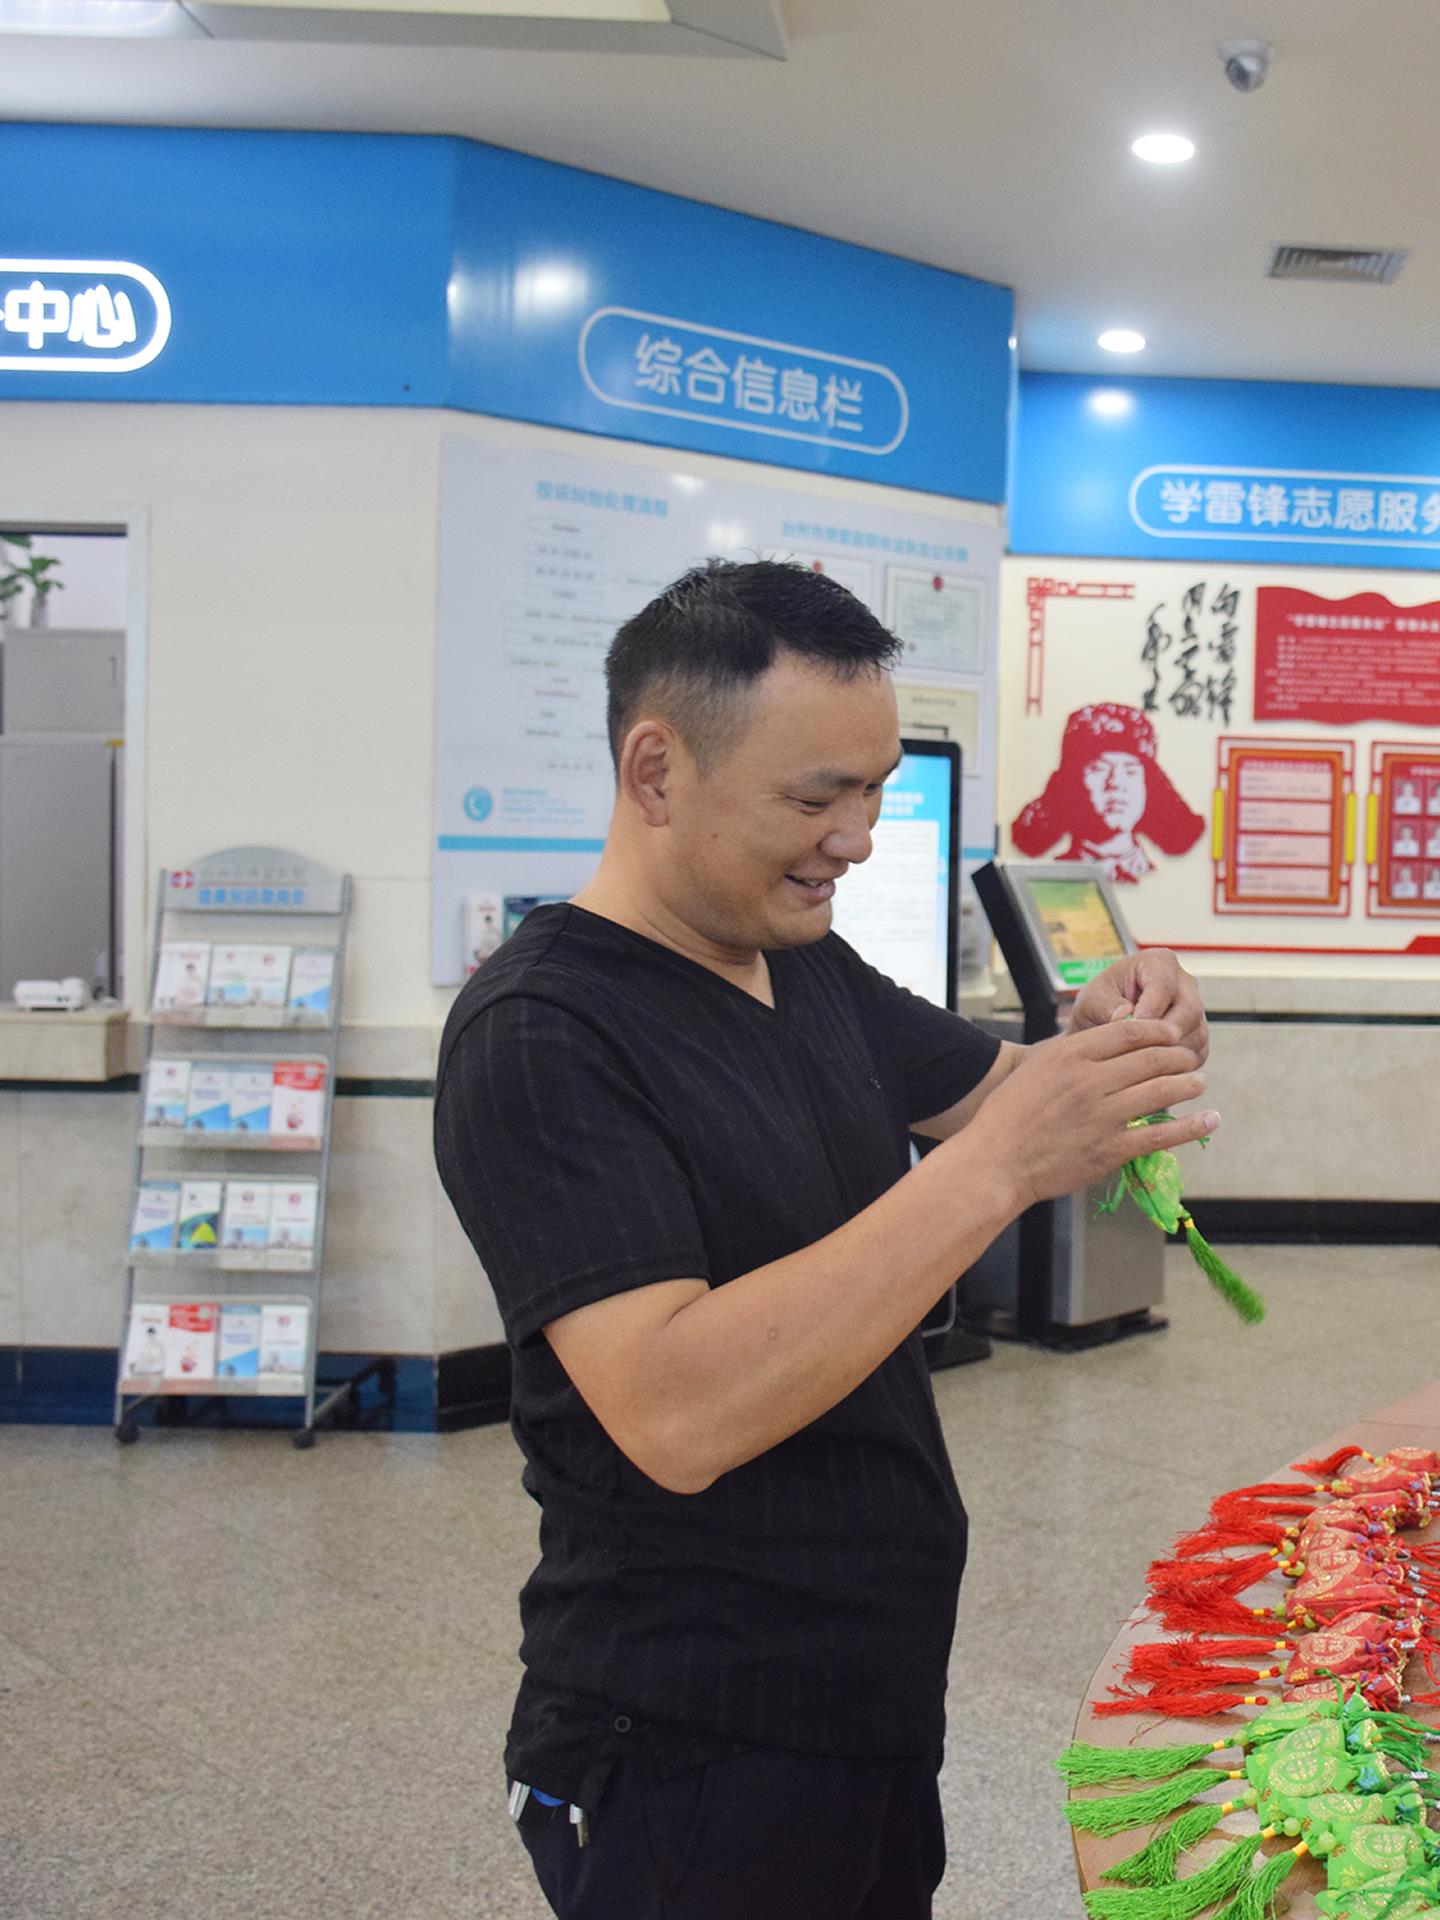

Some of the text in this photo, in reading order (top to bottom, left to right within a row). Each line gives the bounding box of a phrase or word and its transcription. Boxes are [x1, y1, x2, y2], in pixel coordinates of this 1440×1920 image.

[0, 280, 137, 350] 中心
[635, 333, 865, 433] 综合信息栏
